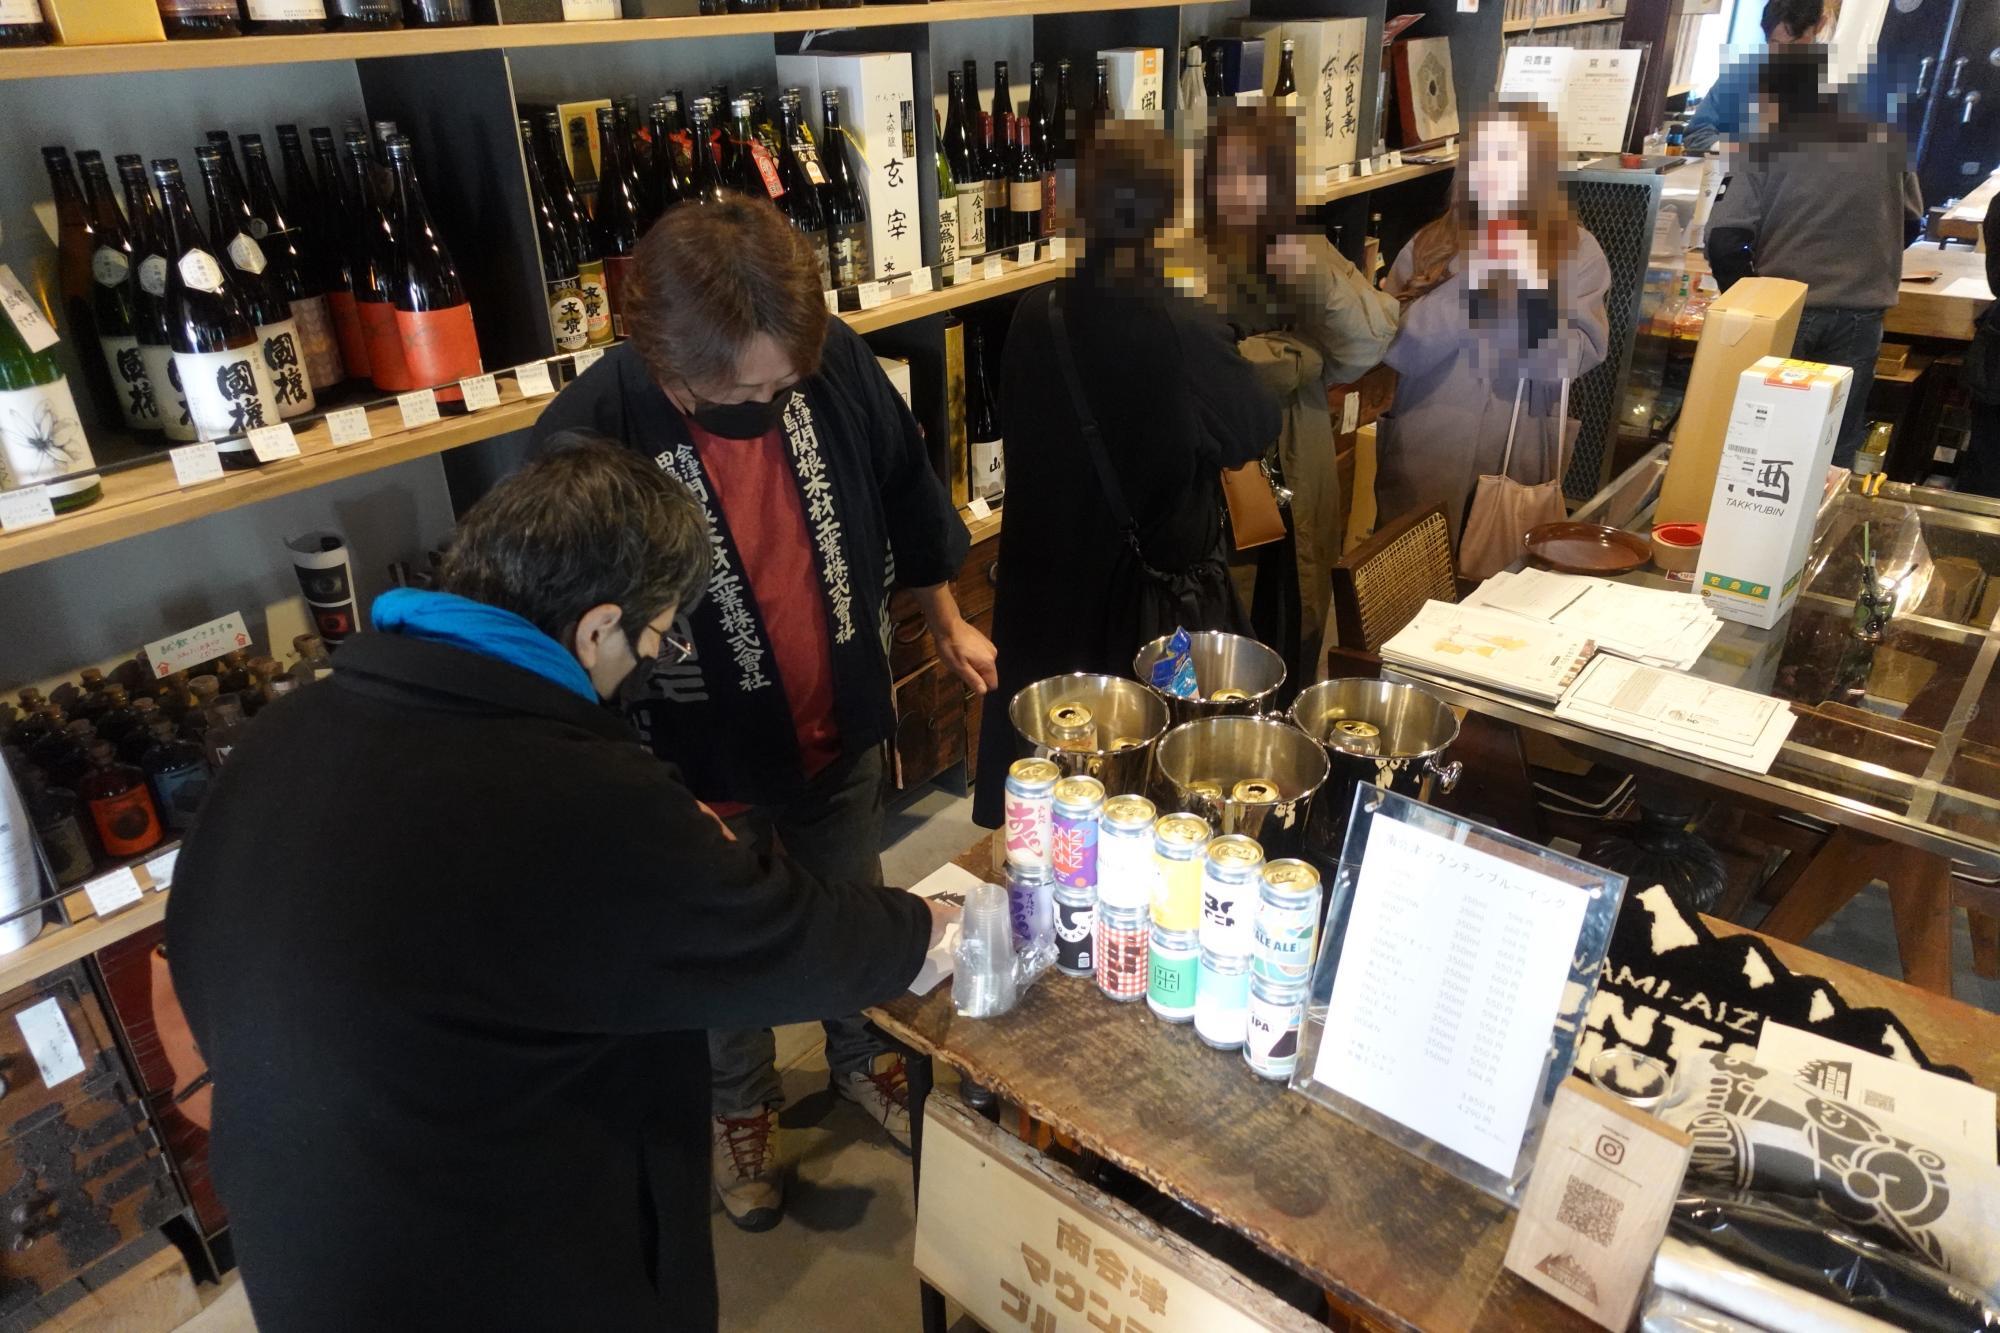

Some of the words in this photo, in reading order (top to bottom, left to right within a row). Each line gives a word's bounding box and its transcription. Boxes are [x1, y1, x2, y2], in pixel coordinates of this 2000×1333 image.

[884, 158, 908, 240] 玄宰
[1726, 497, 1784, 517] TAKKYUBIN
[1710, 576, 1763, 594] 宅急便
[1273, 941, 1296, 952] ALE
[1056, 1217, 1168, 1316] 南会津
